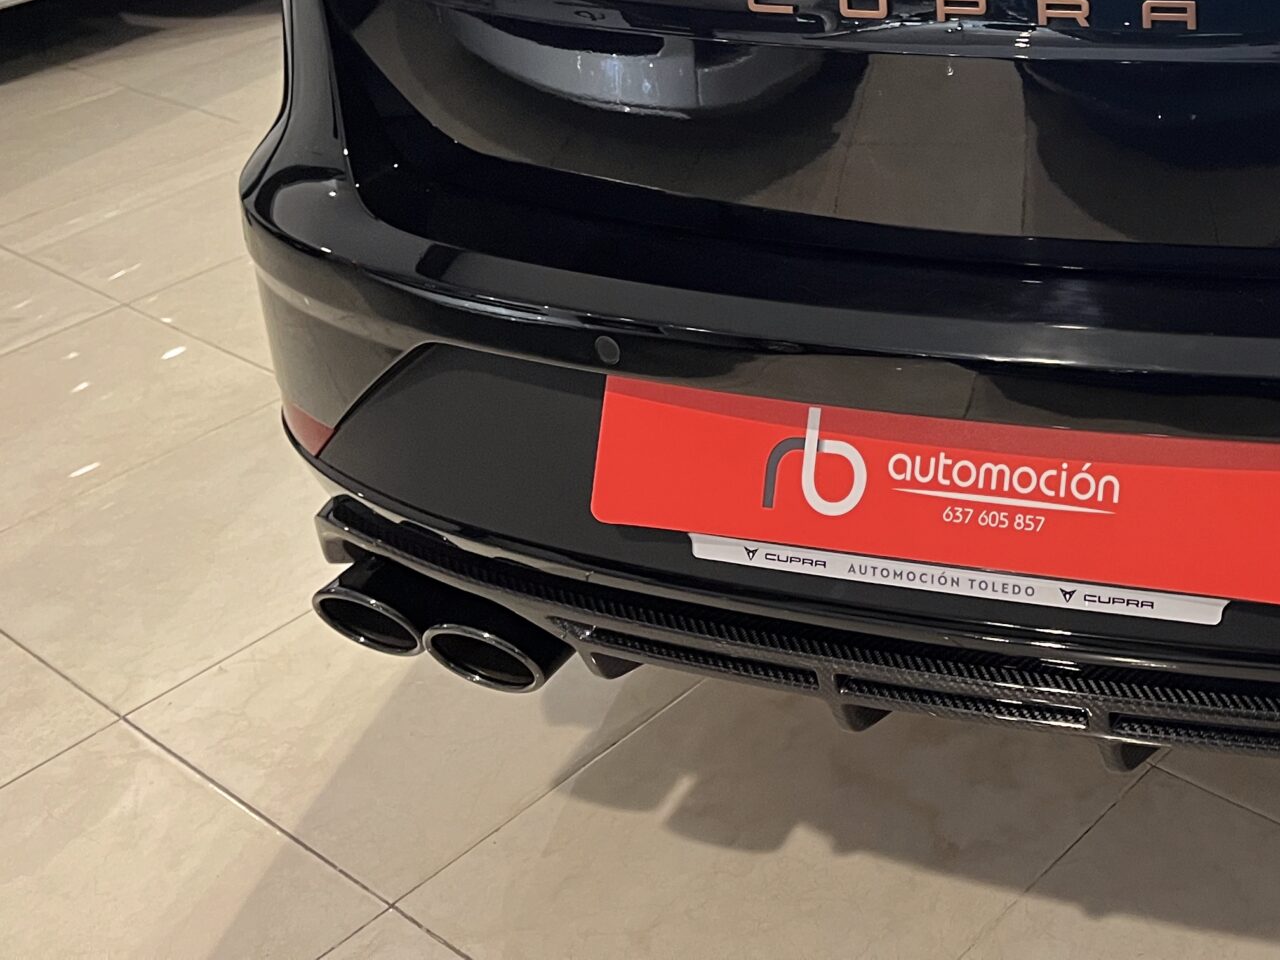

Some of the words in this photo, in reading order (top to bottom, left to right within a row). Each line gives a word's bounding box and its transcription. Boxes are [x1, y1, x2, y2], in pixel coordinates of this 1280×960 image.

[888, 452, 1120, 504] automoción
[942, 506, 974, 525] 637
[977, 510, 1010, 529] 605
[1013, 514, 1046, 533] 857
[764, 551, 827, 570] CUPRA
[847, 563, 961, 588] AUTOMOCIÓN
[967, 578, 1037, 598] TOLEDO
[1083, 592, 1155, 610] CUPRA
